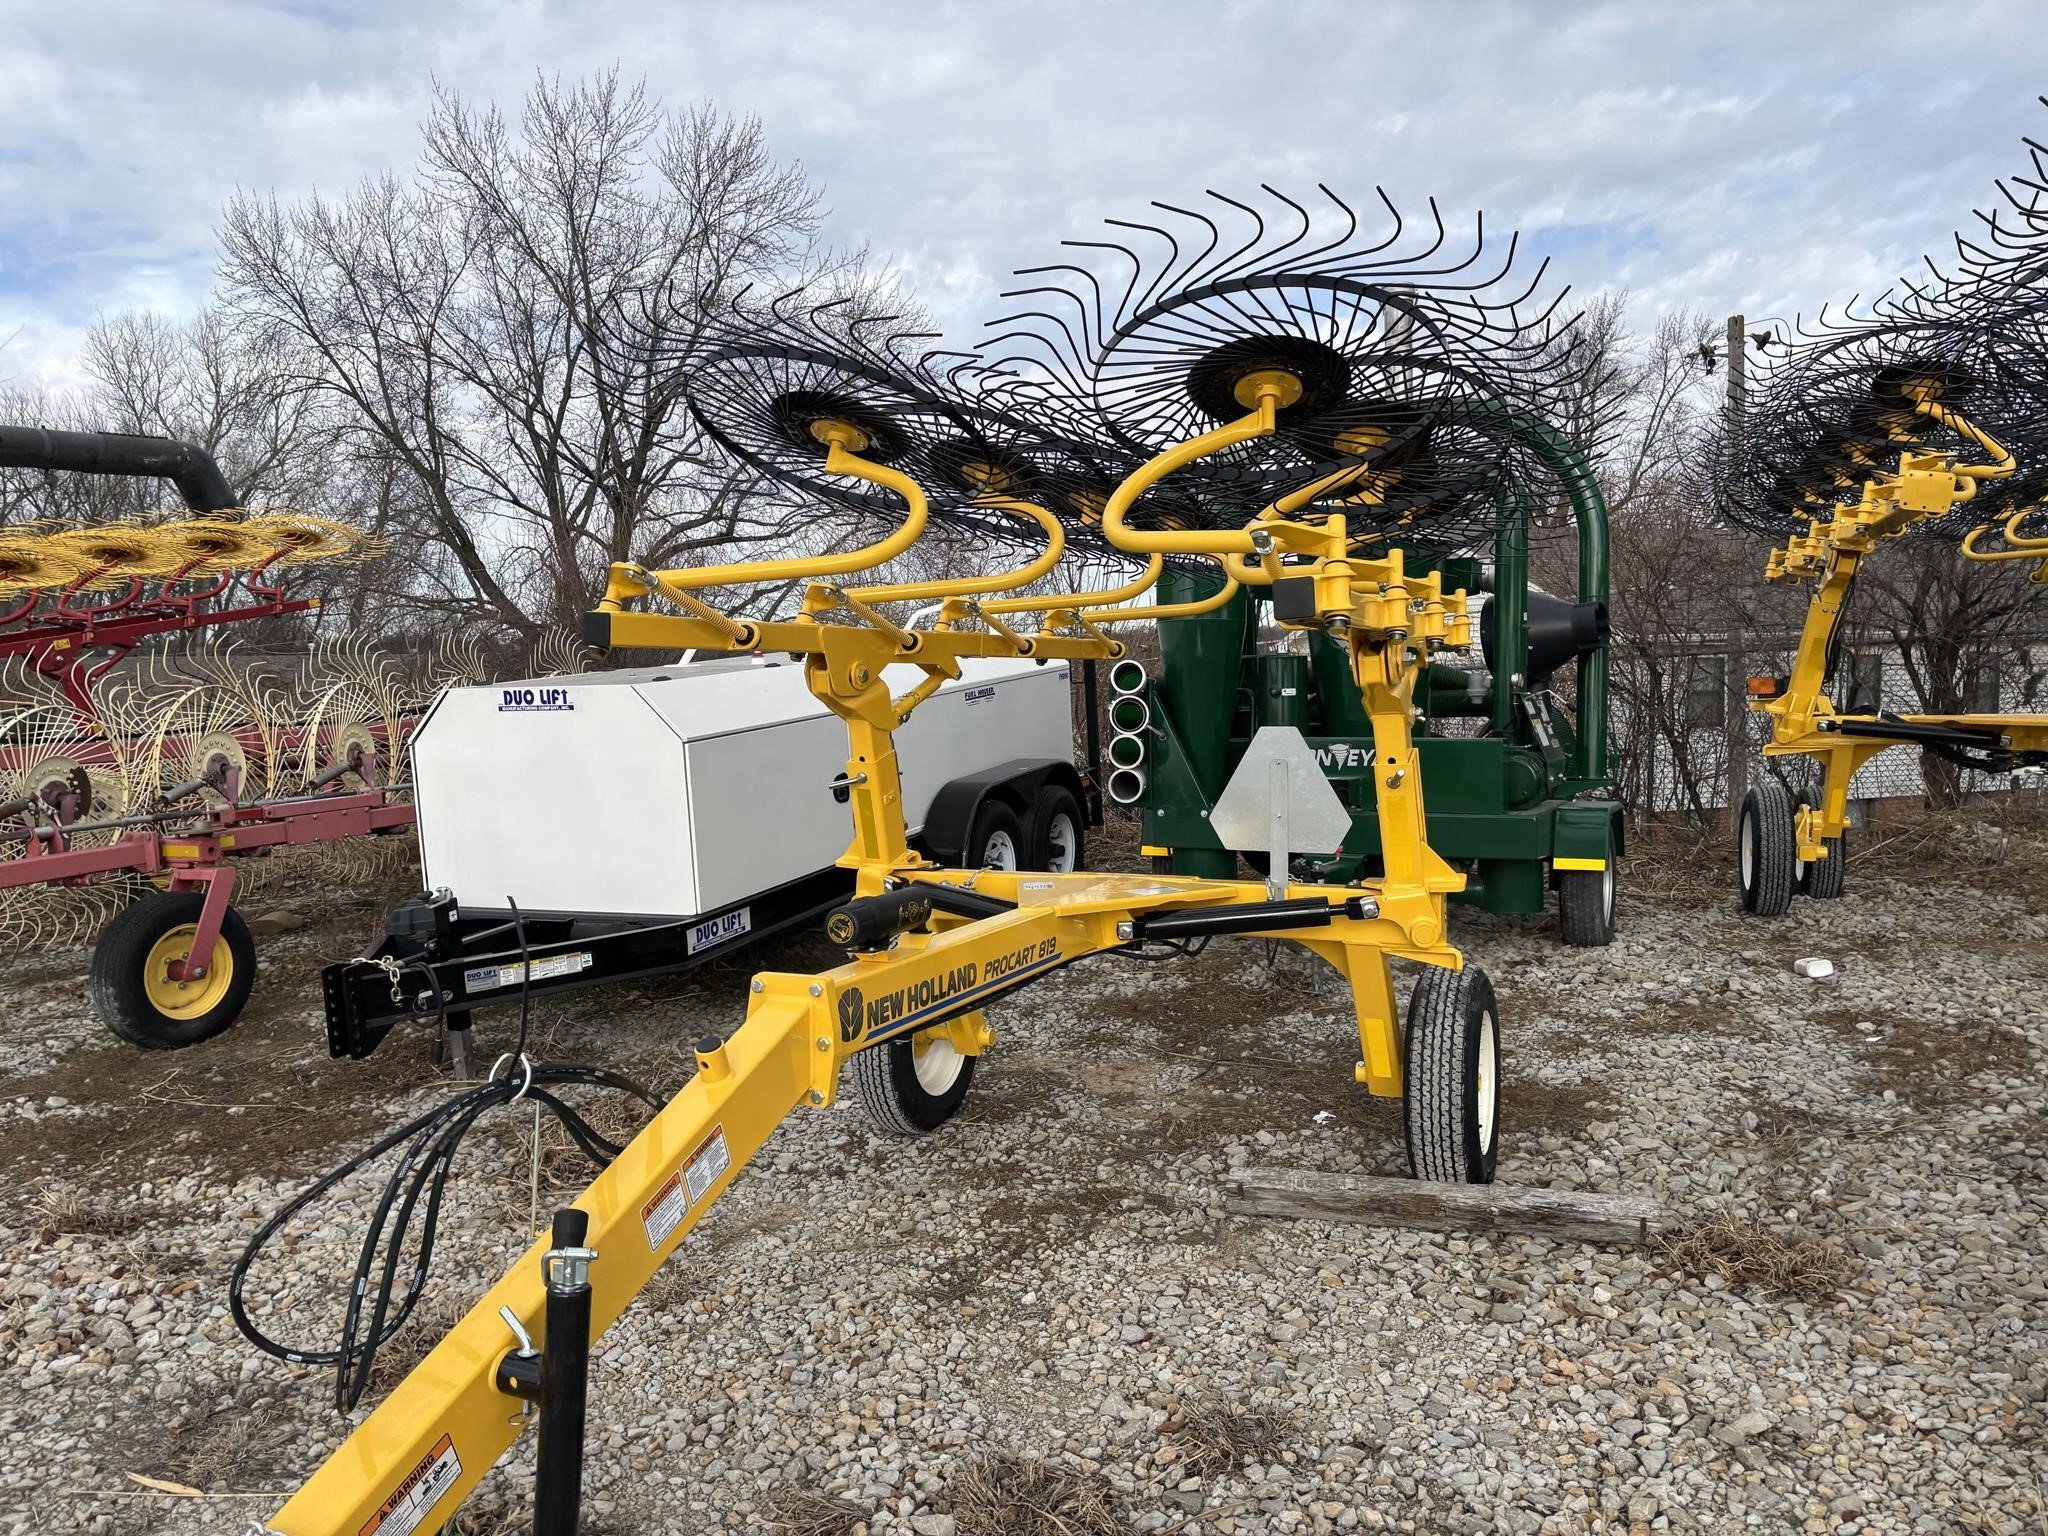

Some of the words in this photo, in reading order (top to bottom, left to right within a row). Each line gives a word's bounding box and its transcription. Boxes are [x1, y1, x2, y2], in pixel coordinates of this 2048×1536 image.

[503, 689, 535, 706] DUO
[540, 689, 568, 705] LIFT
[696, 921, 719, 943] DUO
[722, 912, 742, 932] LIFT
[466, 971, 482, 980] DUO
[867, 988, 905, 1030] NEW
[907, 962, 977, 1013] HOLLAND
[983, 944, 1037, 981] PROCART
[1038, 936, 1057, 958] 819
[652, 1179, 677, 1208] WARNING
[387, 1453, 435, 1509] WARNING
